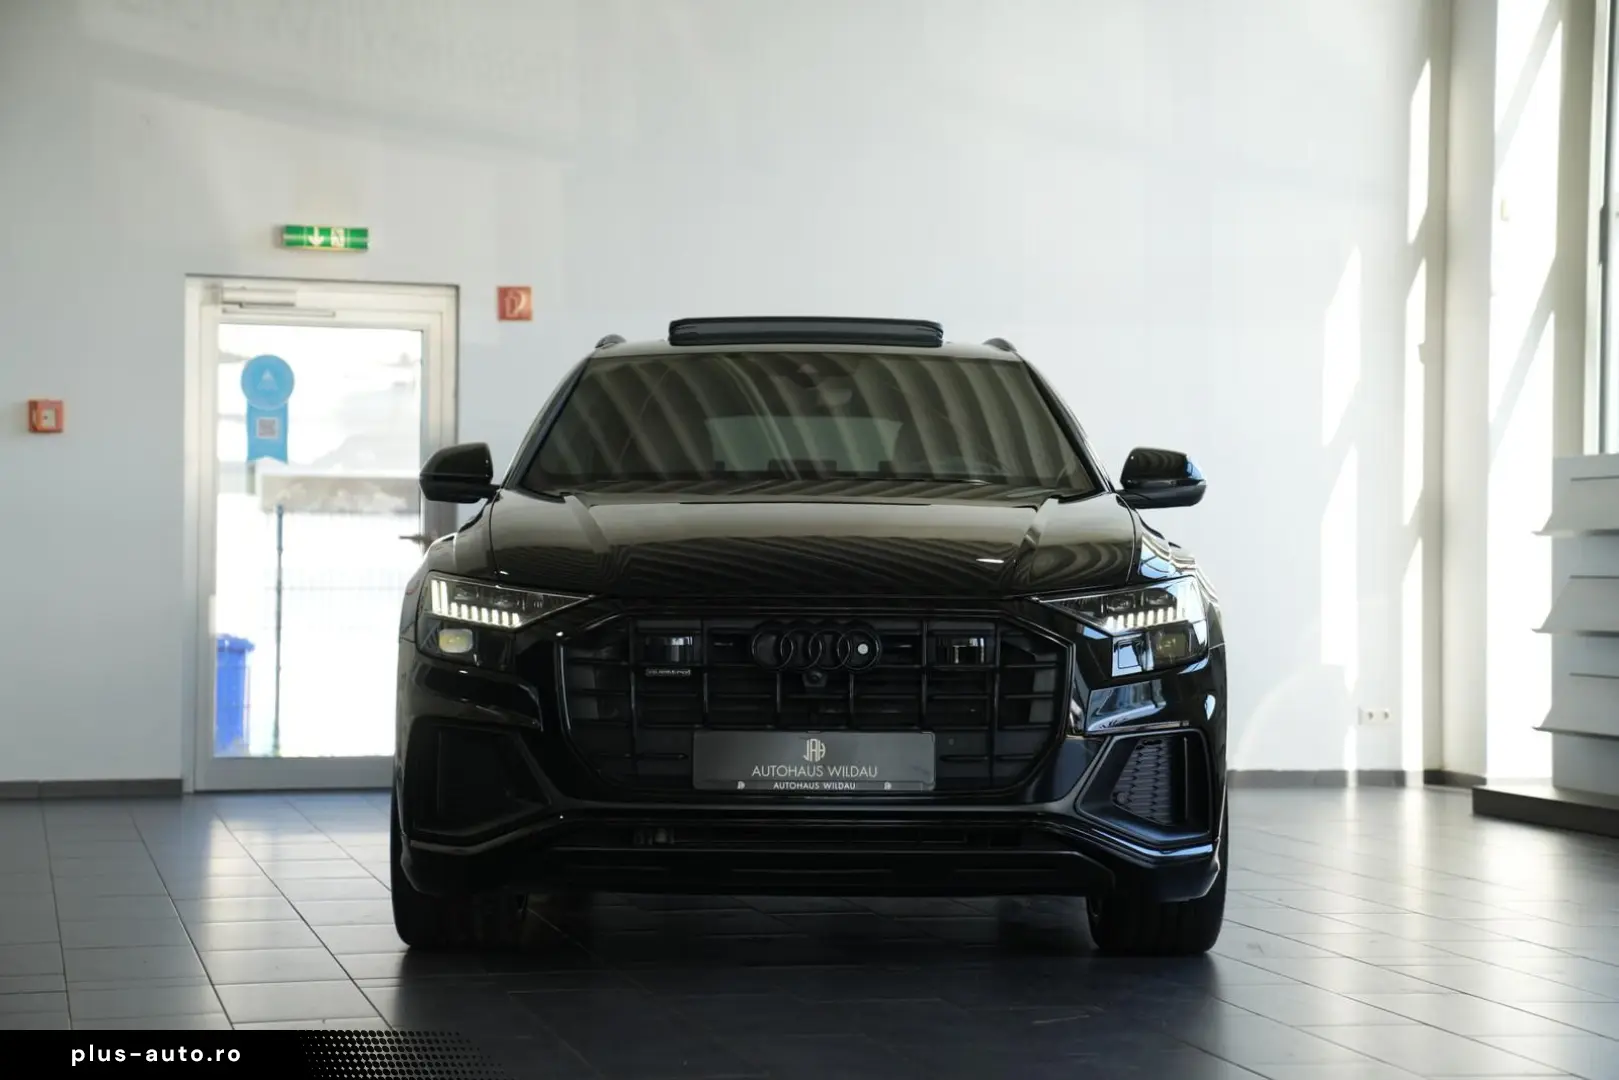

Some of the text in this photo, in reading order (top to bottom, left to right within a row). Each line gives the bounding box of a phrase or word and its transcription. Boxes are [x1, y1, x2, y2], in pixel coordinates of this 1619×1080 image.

[751, 765, 878, 778] AUTOHAUS WILDAU
[773, 781, 856, 790] AUTOHAUS WILDAU
